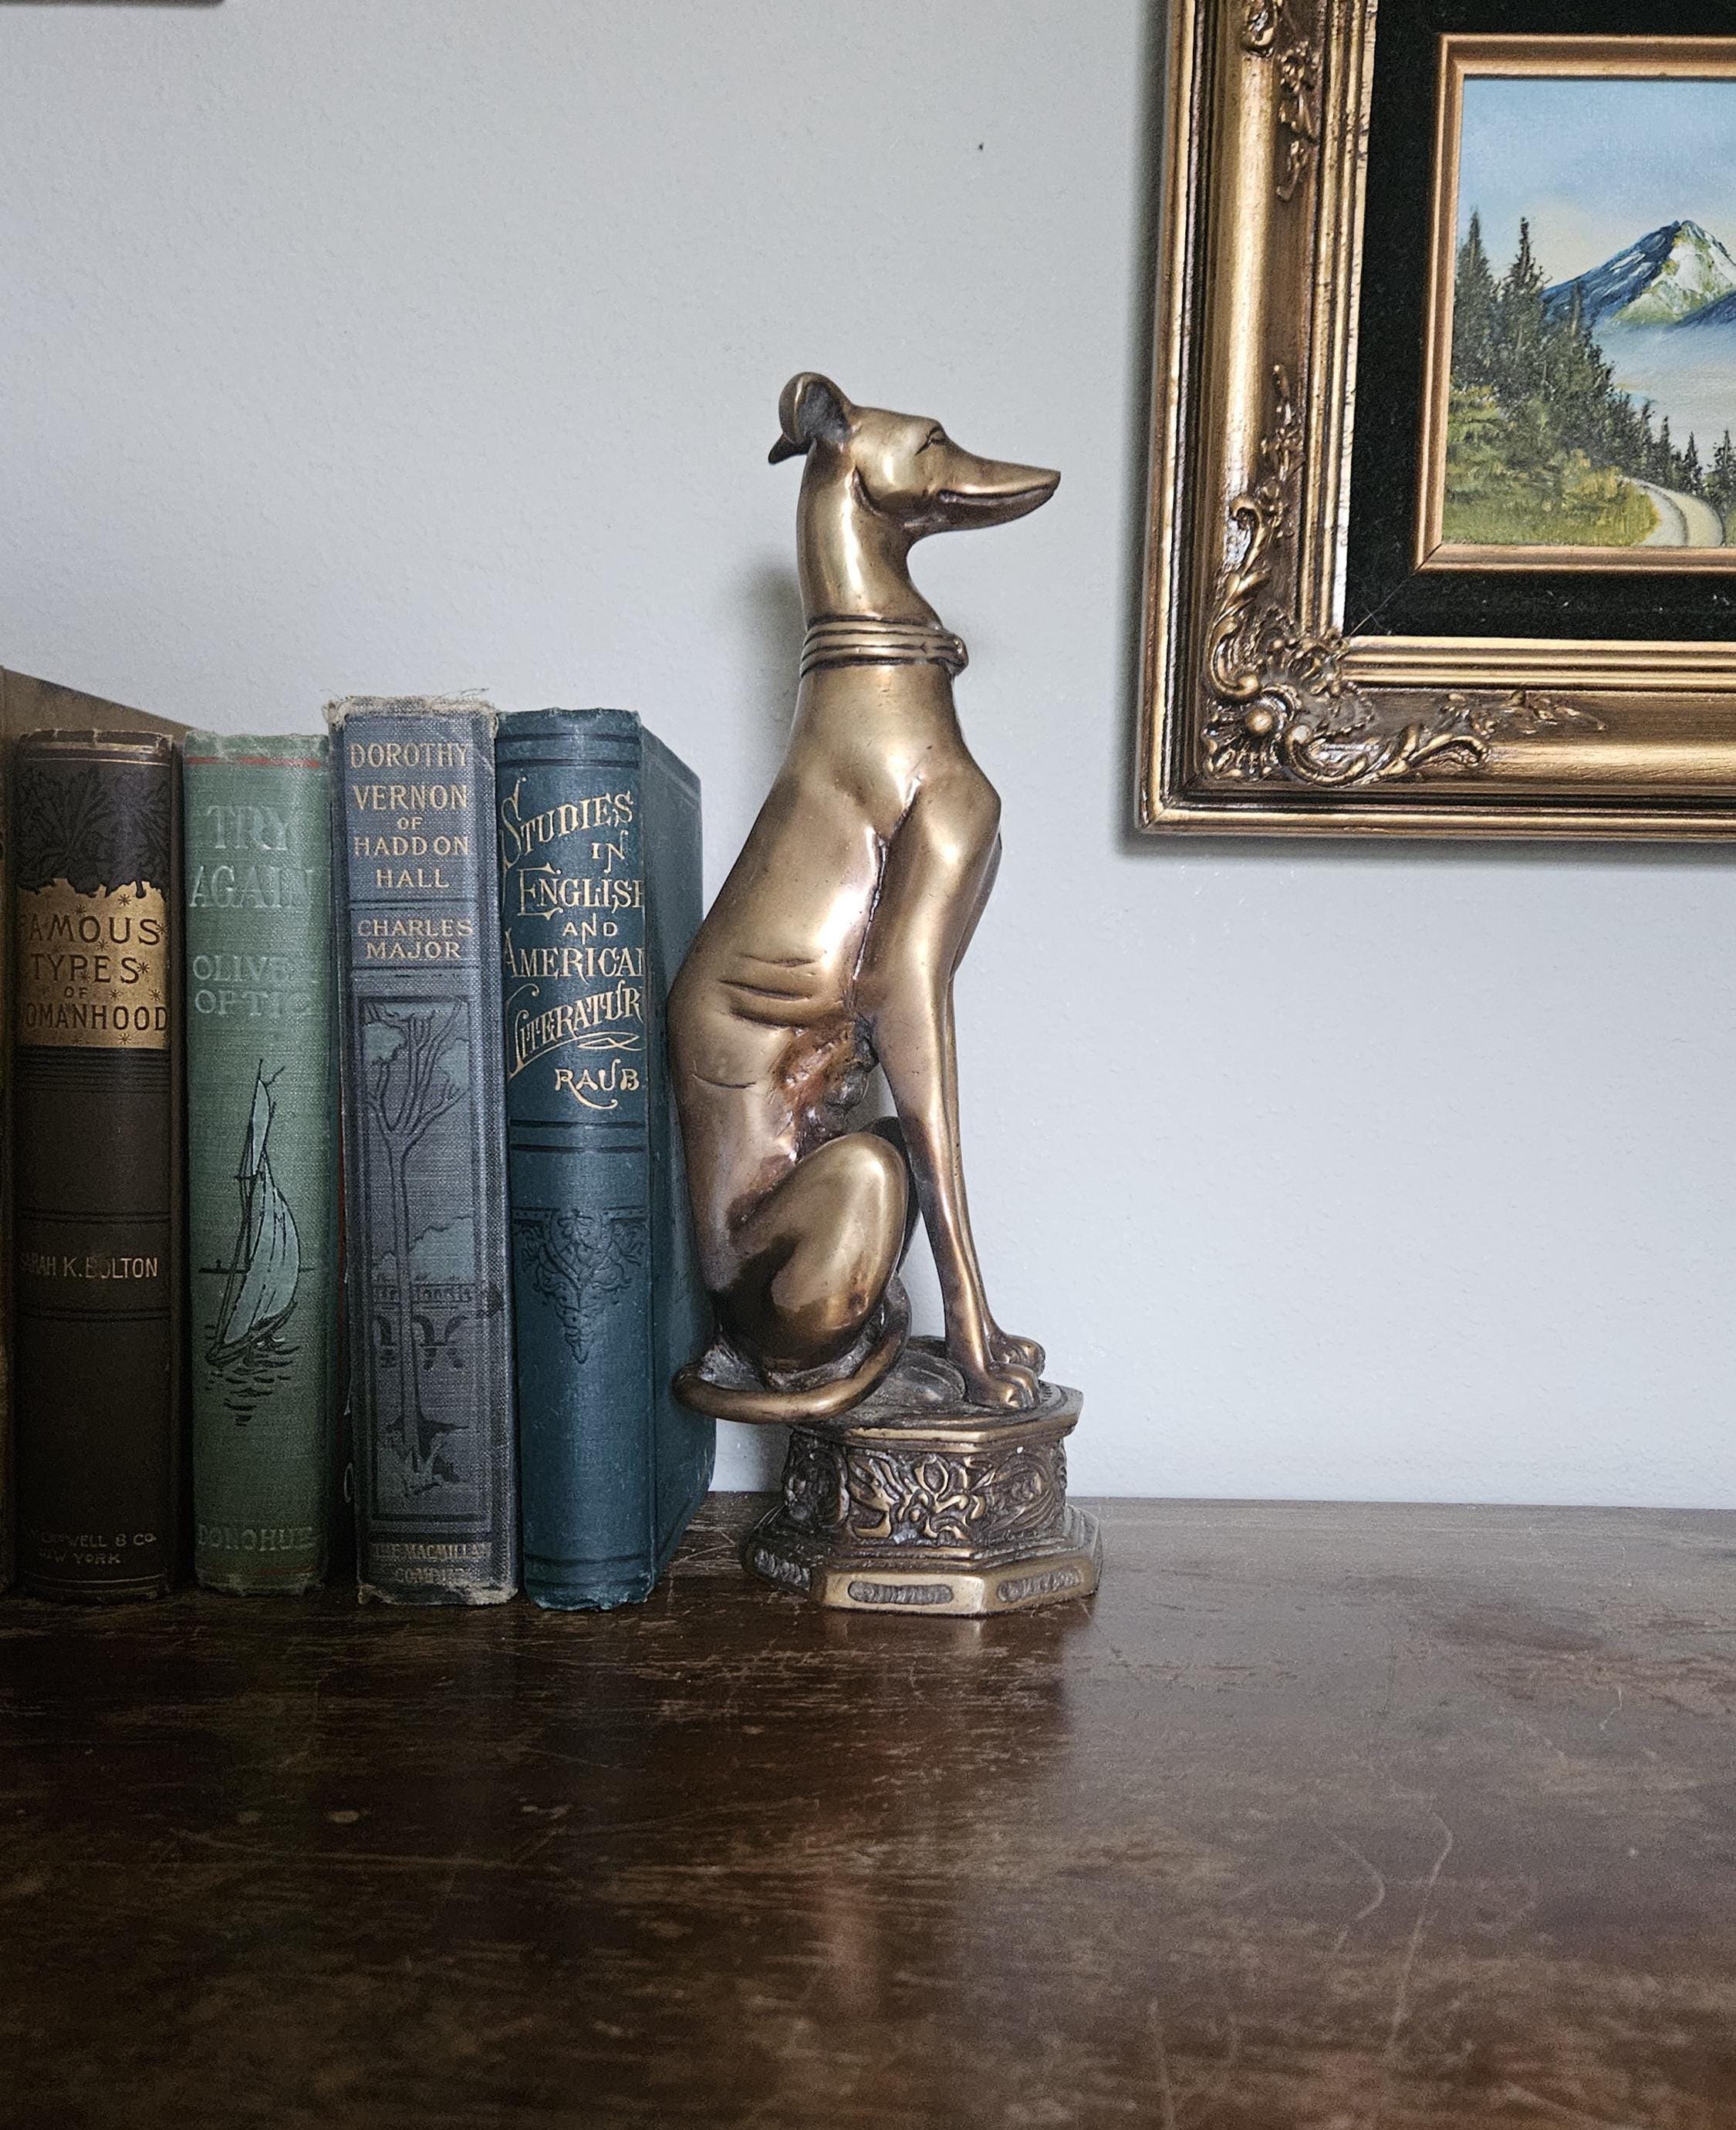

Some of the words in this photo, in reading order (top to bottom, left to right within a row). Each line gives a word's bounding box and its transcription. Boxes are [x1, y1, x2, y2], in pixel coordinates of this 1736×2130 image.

[350, 742, 468, 768] DOROTHY
[353, 784, 468, 811] VERNON
[207, 805, 290, 850] TRY
[397, 817, 423, 831] OF
[500, 777, 634, 870] STUDIES
[353, 836, 469, 857] HADDON
[591, 829, 629, 873] IN
[190, 865, 315, 908] AGAIN
[377, 868, 450, 888] HALL
[22, 913, 160, 946] AMOUS
[357, 920, 474, 937] CHARLES
[562, 913, 618, 945] AND
[366, 941, 461, 960] MAJOR
[31, 953, 140, 984] TYPES
[193, 954, 319, 984] OLIVE
[64, 986, 89, 999] OF
[21, 1002, 168, 1031] OMANHOOD
[506, 980, 645, 1079] LITERATUR
[555, 1058, 640, 1109] RAUB
